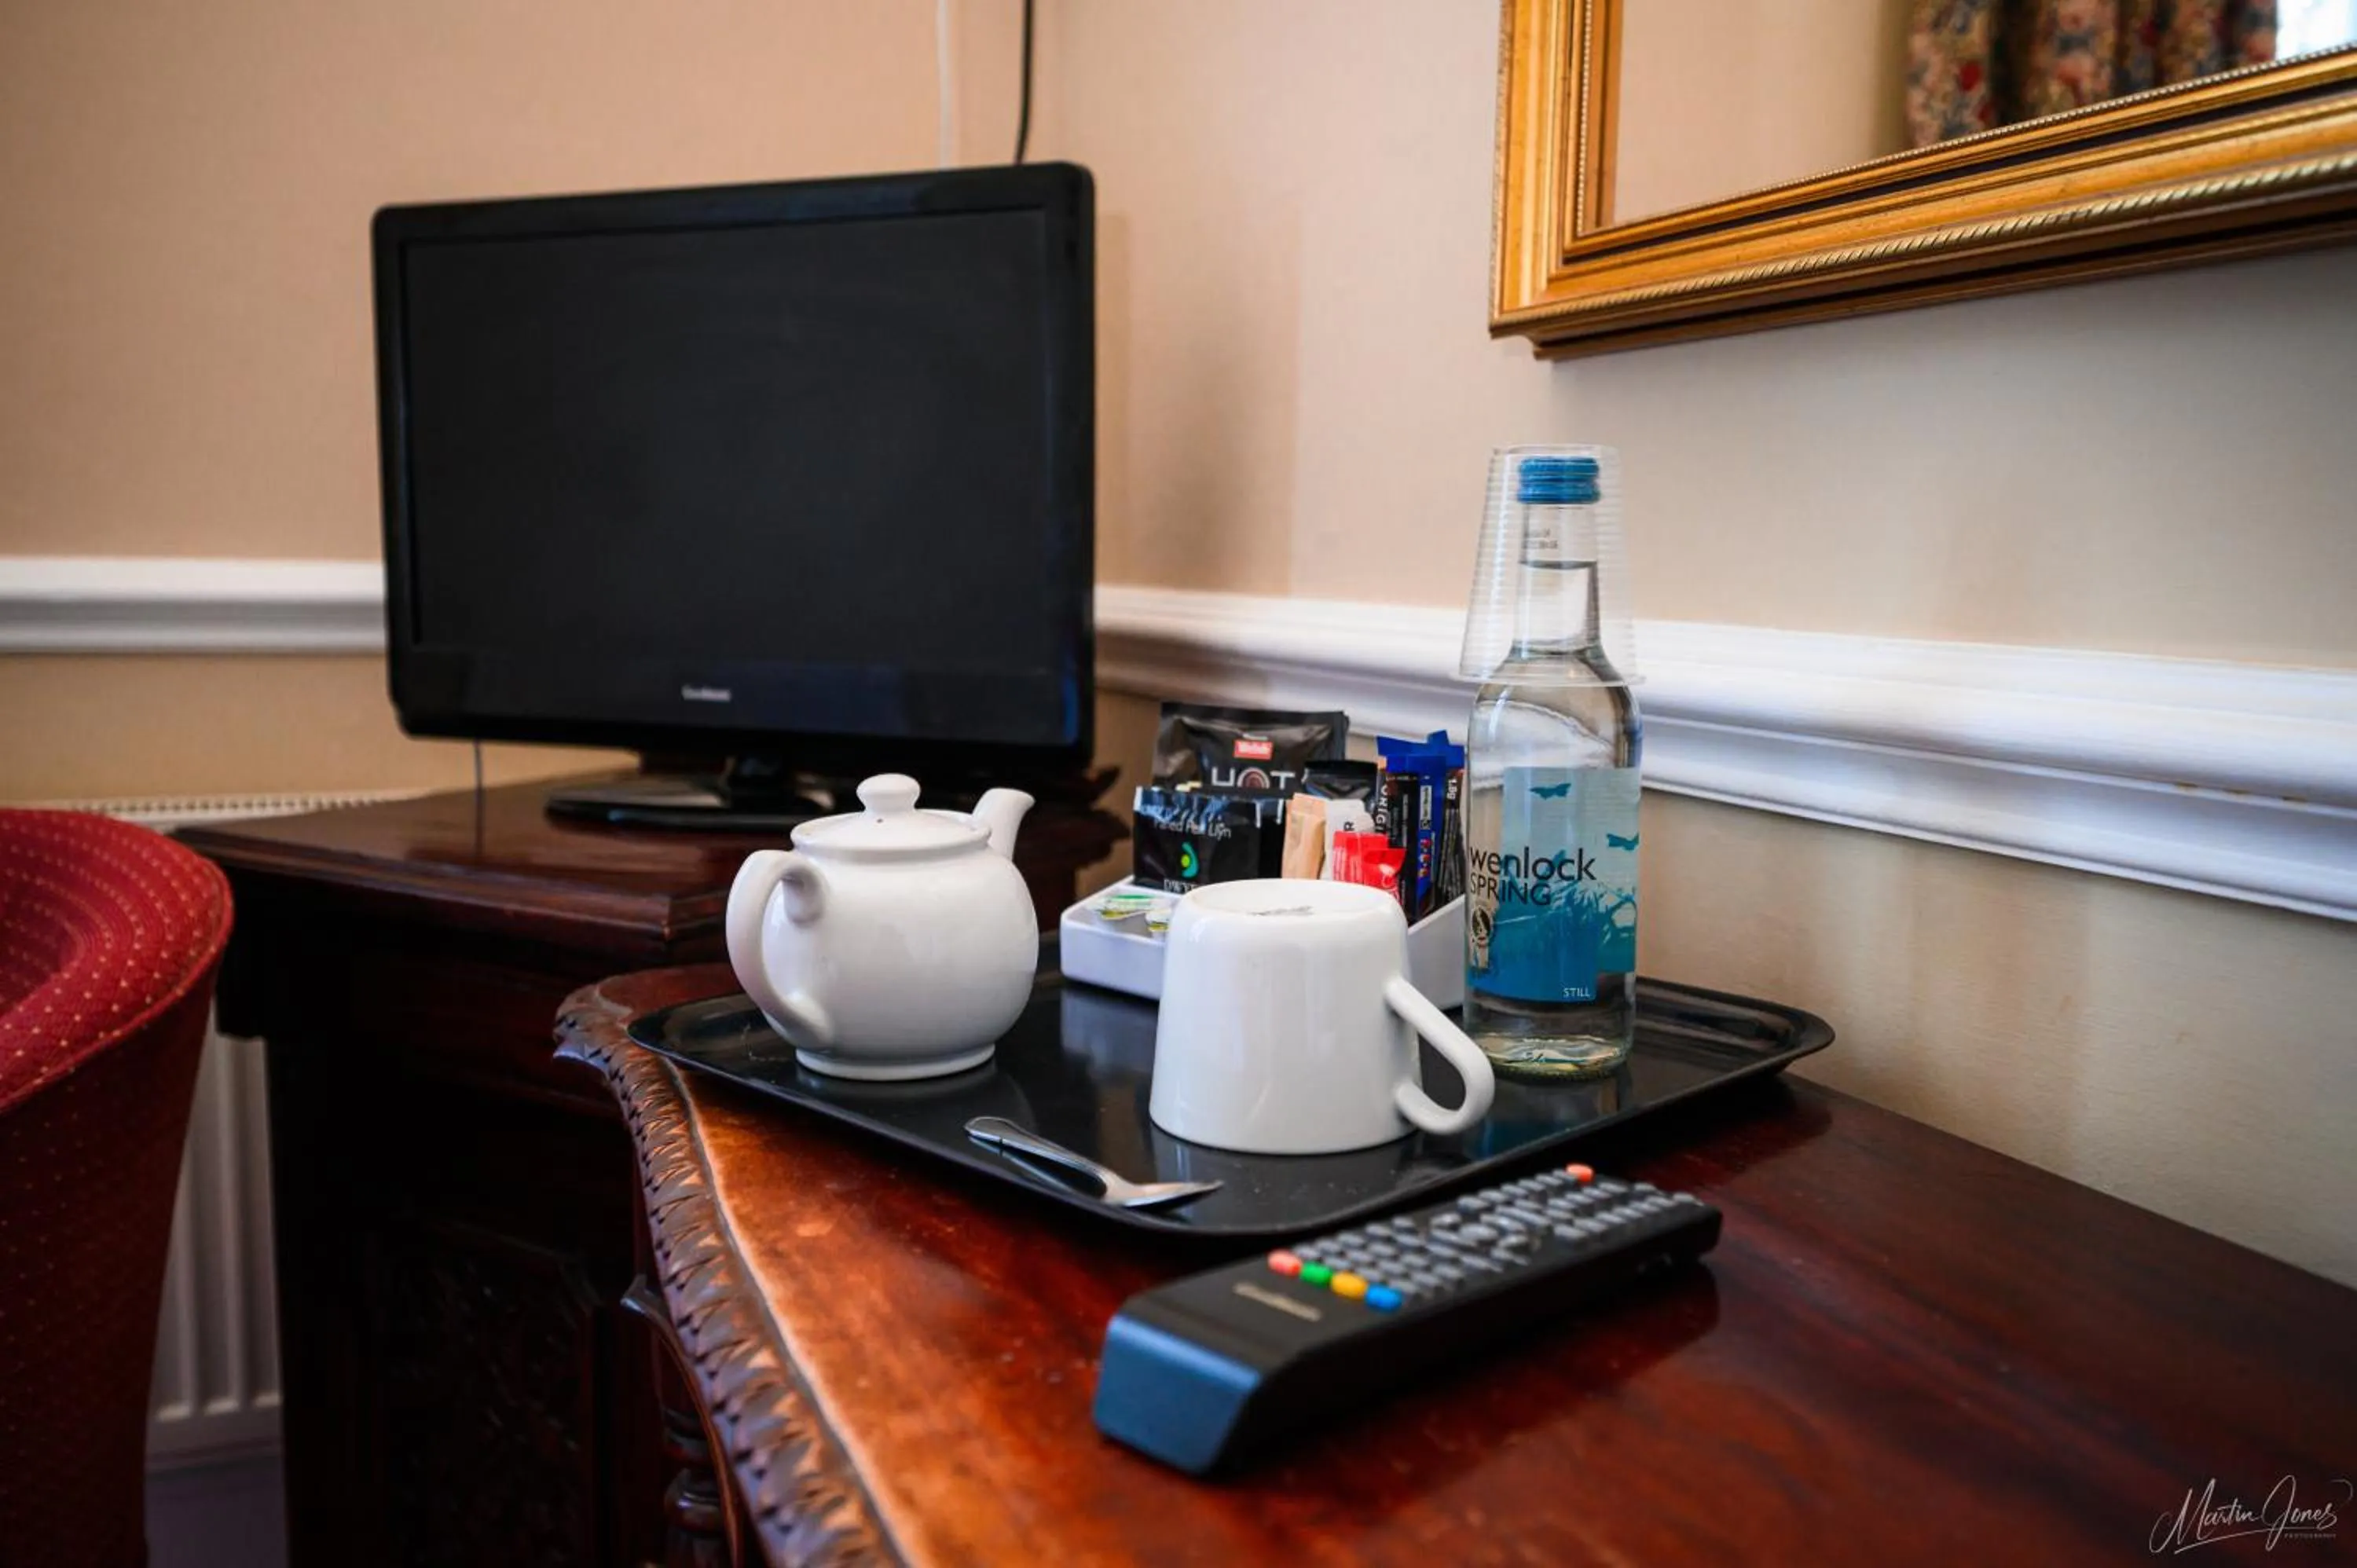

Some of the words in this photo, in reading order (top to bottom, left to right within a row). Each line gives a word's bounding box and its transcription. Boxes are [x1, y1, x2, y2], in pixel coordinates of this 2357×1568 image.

[1470, 846, 1597, 881] wenlock
[1470, 872, 1552, 906] SPRING
[1563, 987, 1591, 998] STILL
